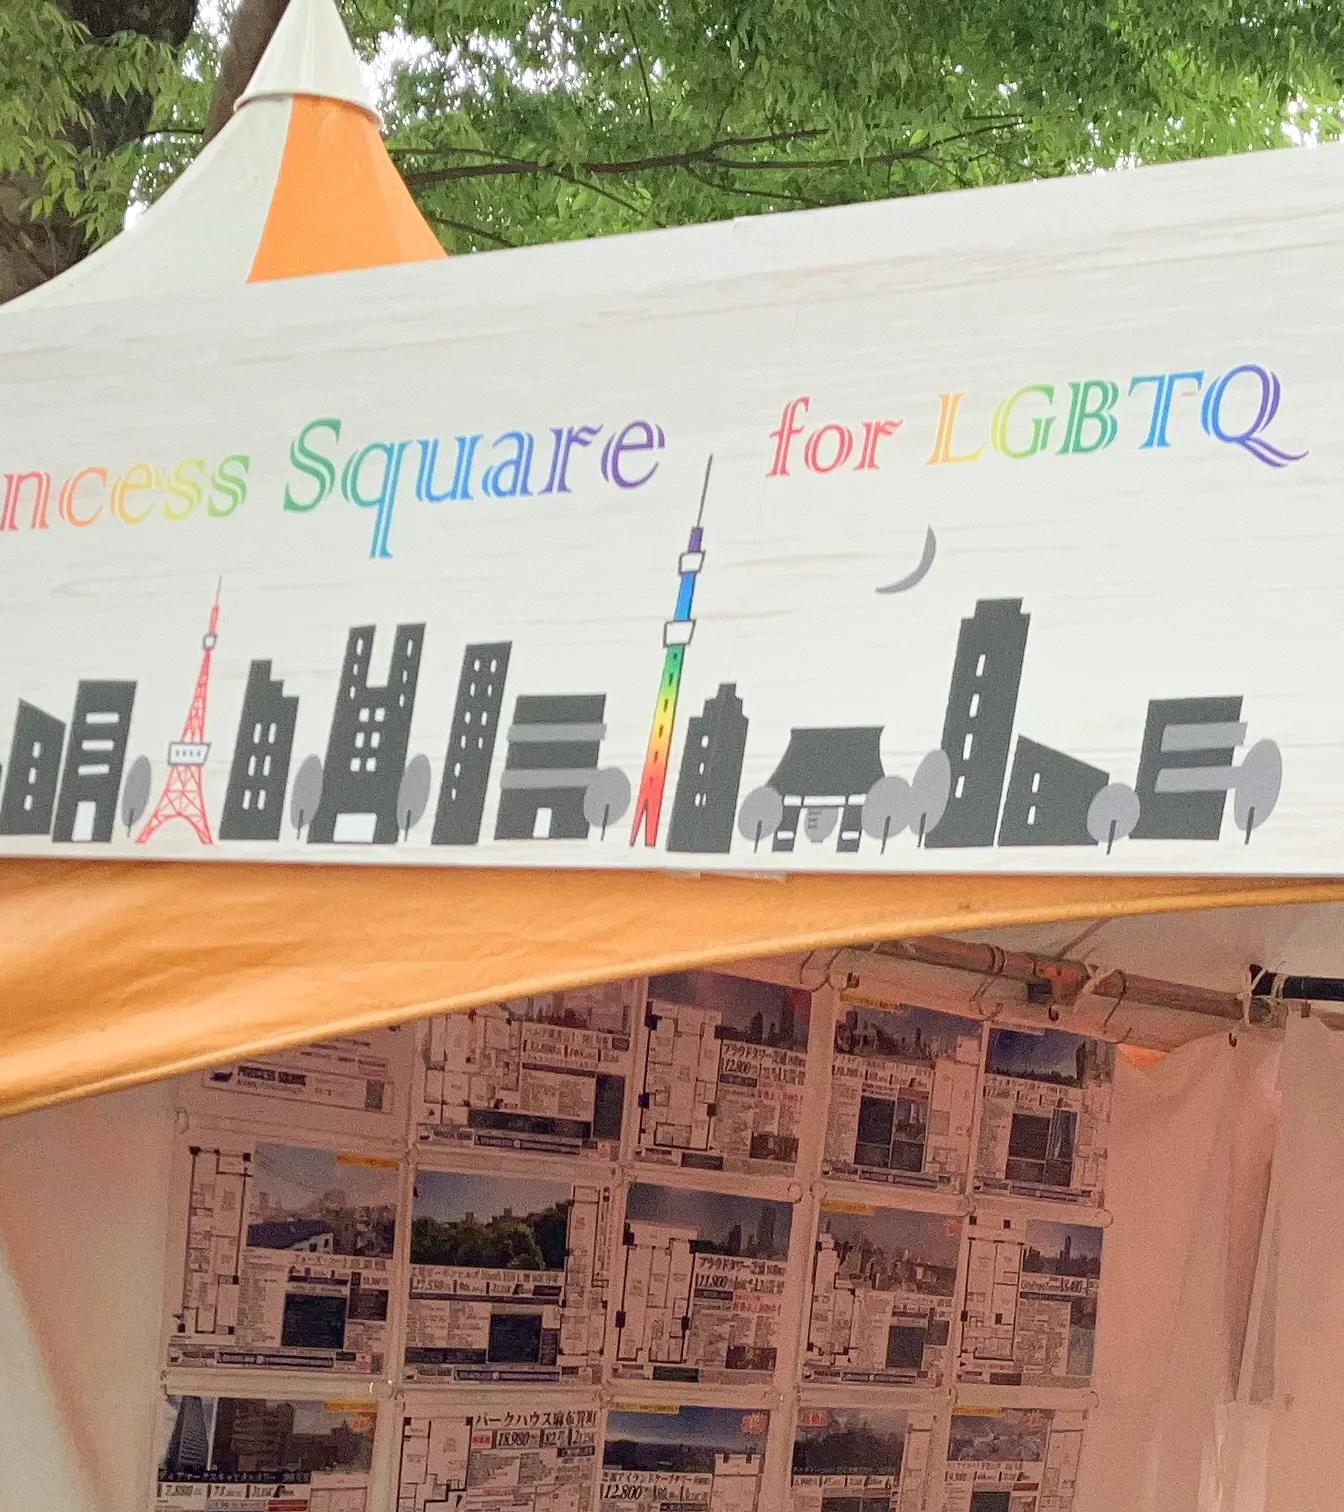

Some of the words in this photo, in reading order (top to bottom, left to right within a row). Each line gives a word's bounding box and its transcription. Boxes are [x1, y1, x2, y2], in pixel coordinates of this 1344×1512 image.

[282, 417, 664, 559] Square
[766, 395, 903, 478] for
[925, 363, 1310, 468] LGBTQ
